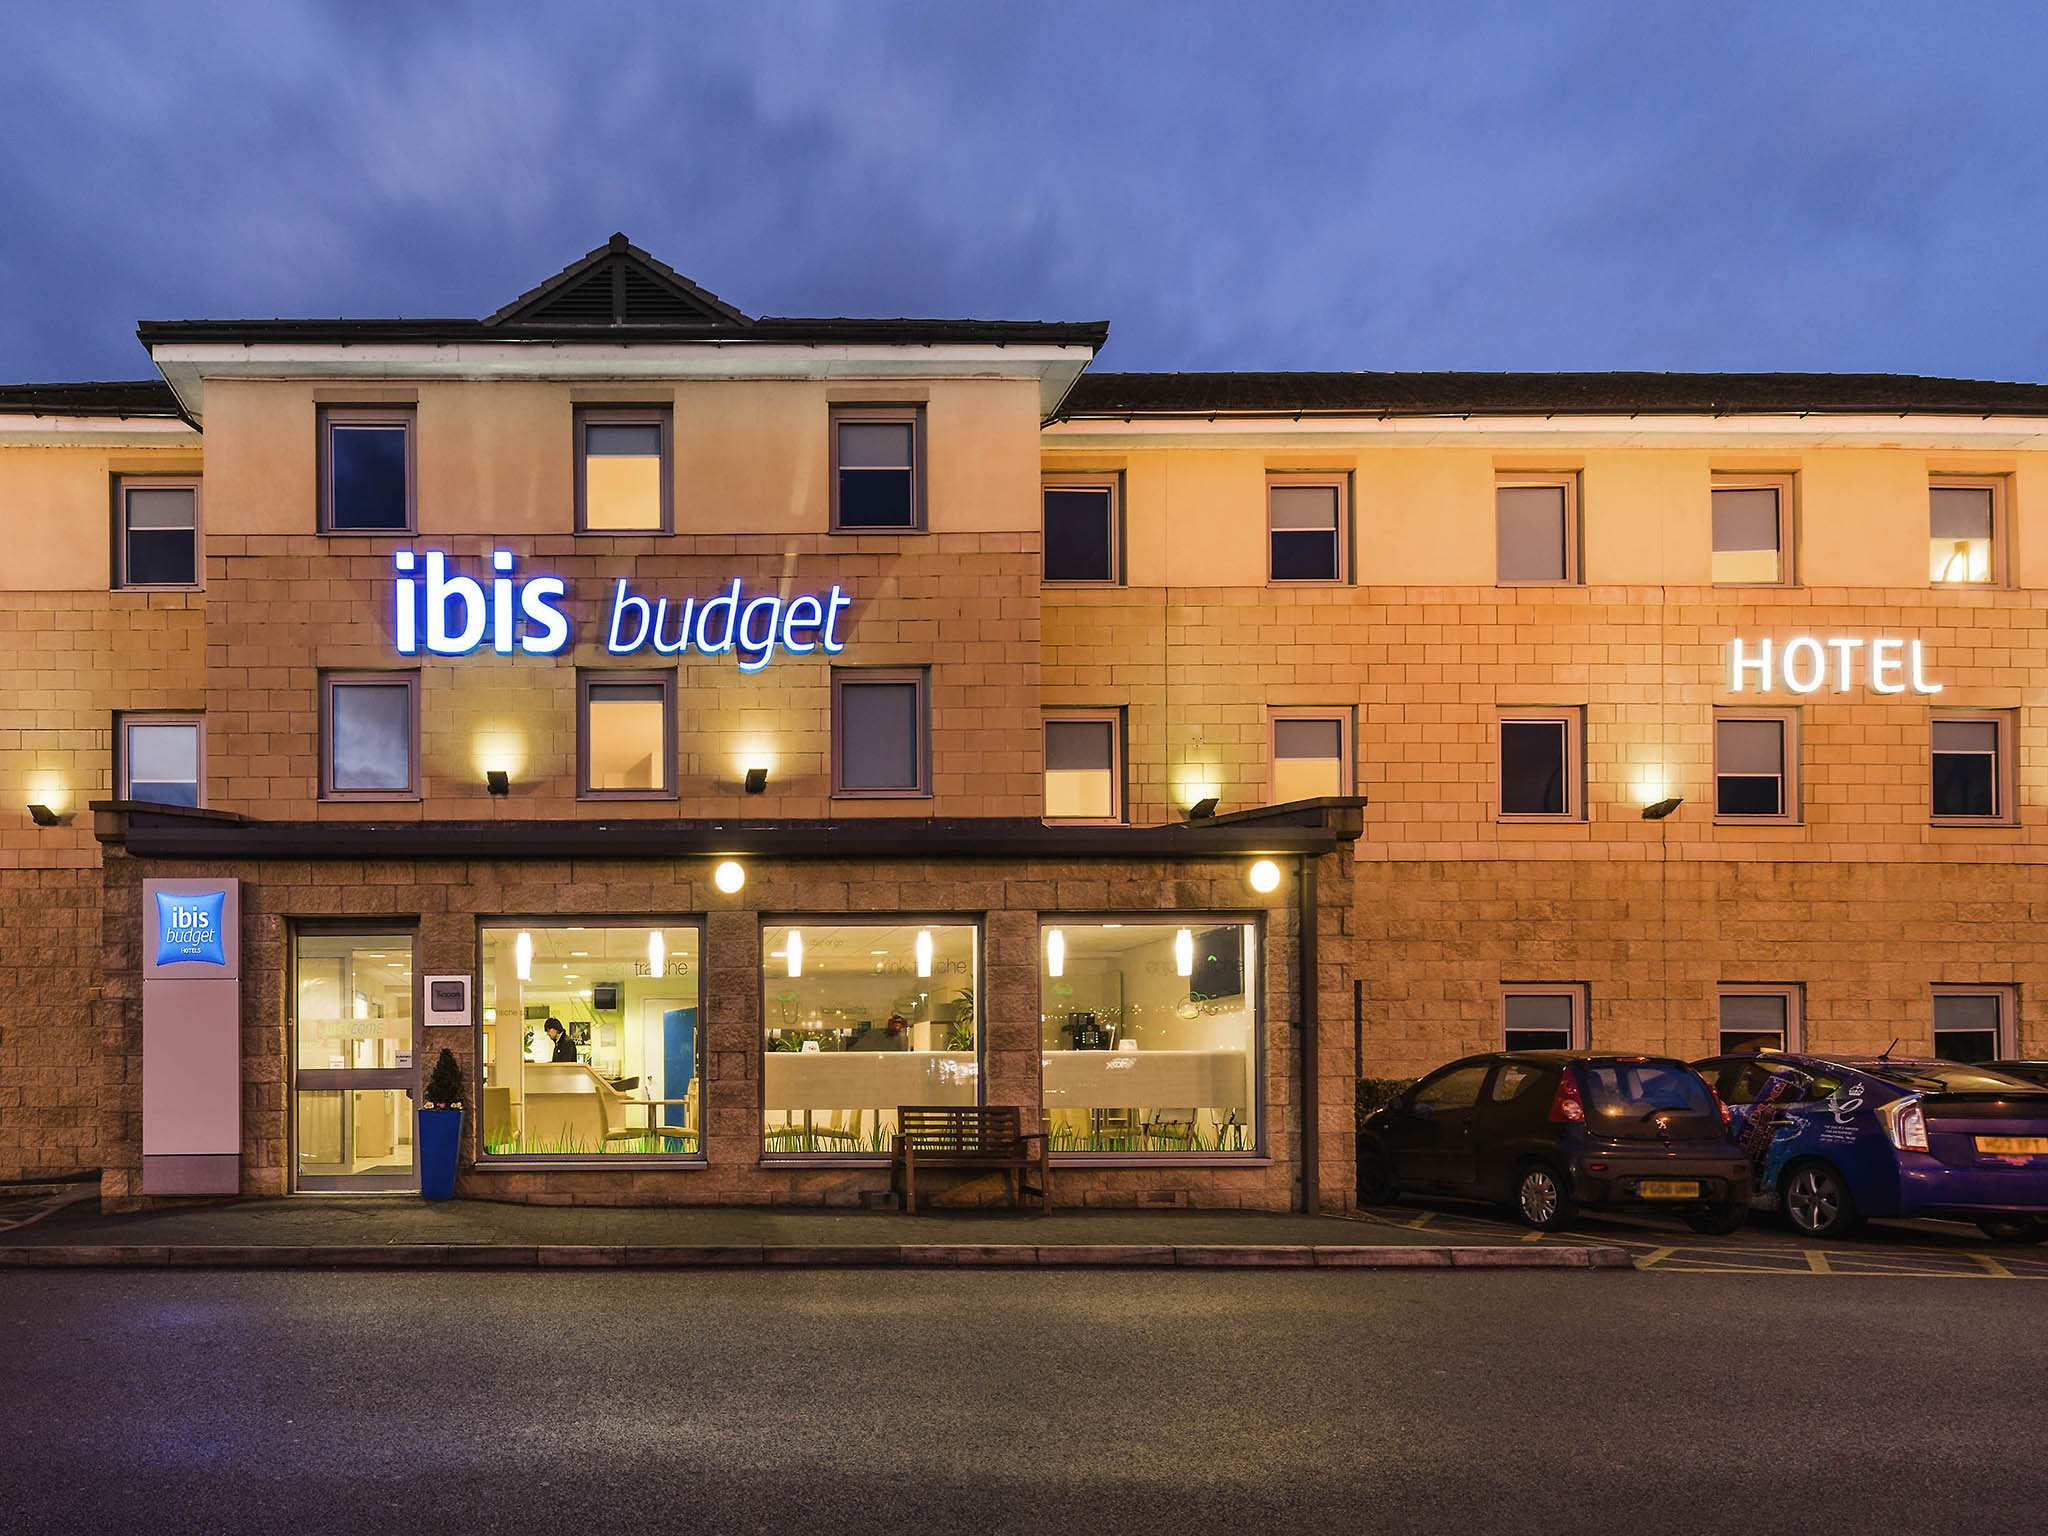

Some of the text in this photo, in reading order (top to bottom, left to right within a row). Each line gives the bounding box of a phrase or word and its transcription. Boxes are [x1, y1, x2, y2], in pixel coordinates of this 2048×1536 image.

[395, 550, 851, 673] ibis budget
[1728, 637, 1943, 694] HOTEL
[172, 906, 209, 928] ibis
[166, 928, 215, 946] budget
[634, 959, 688, 976] frahe
